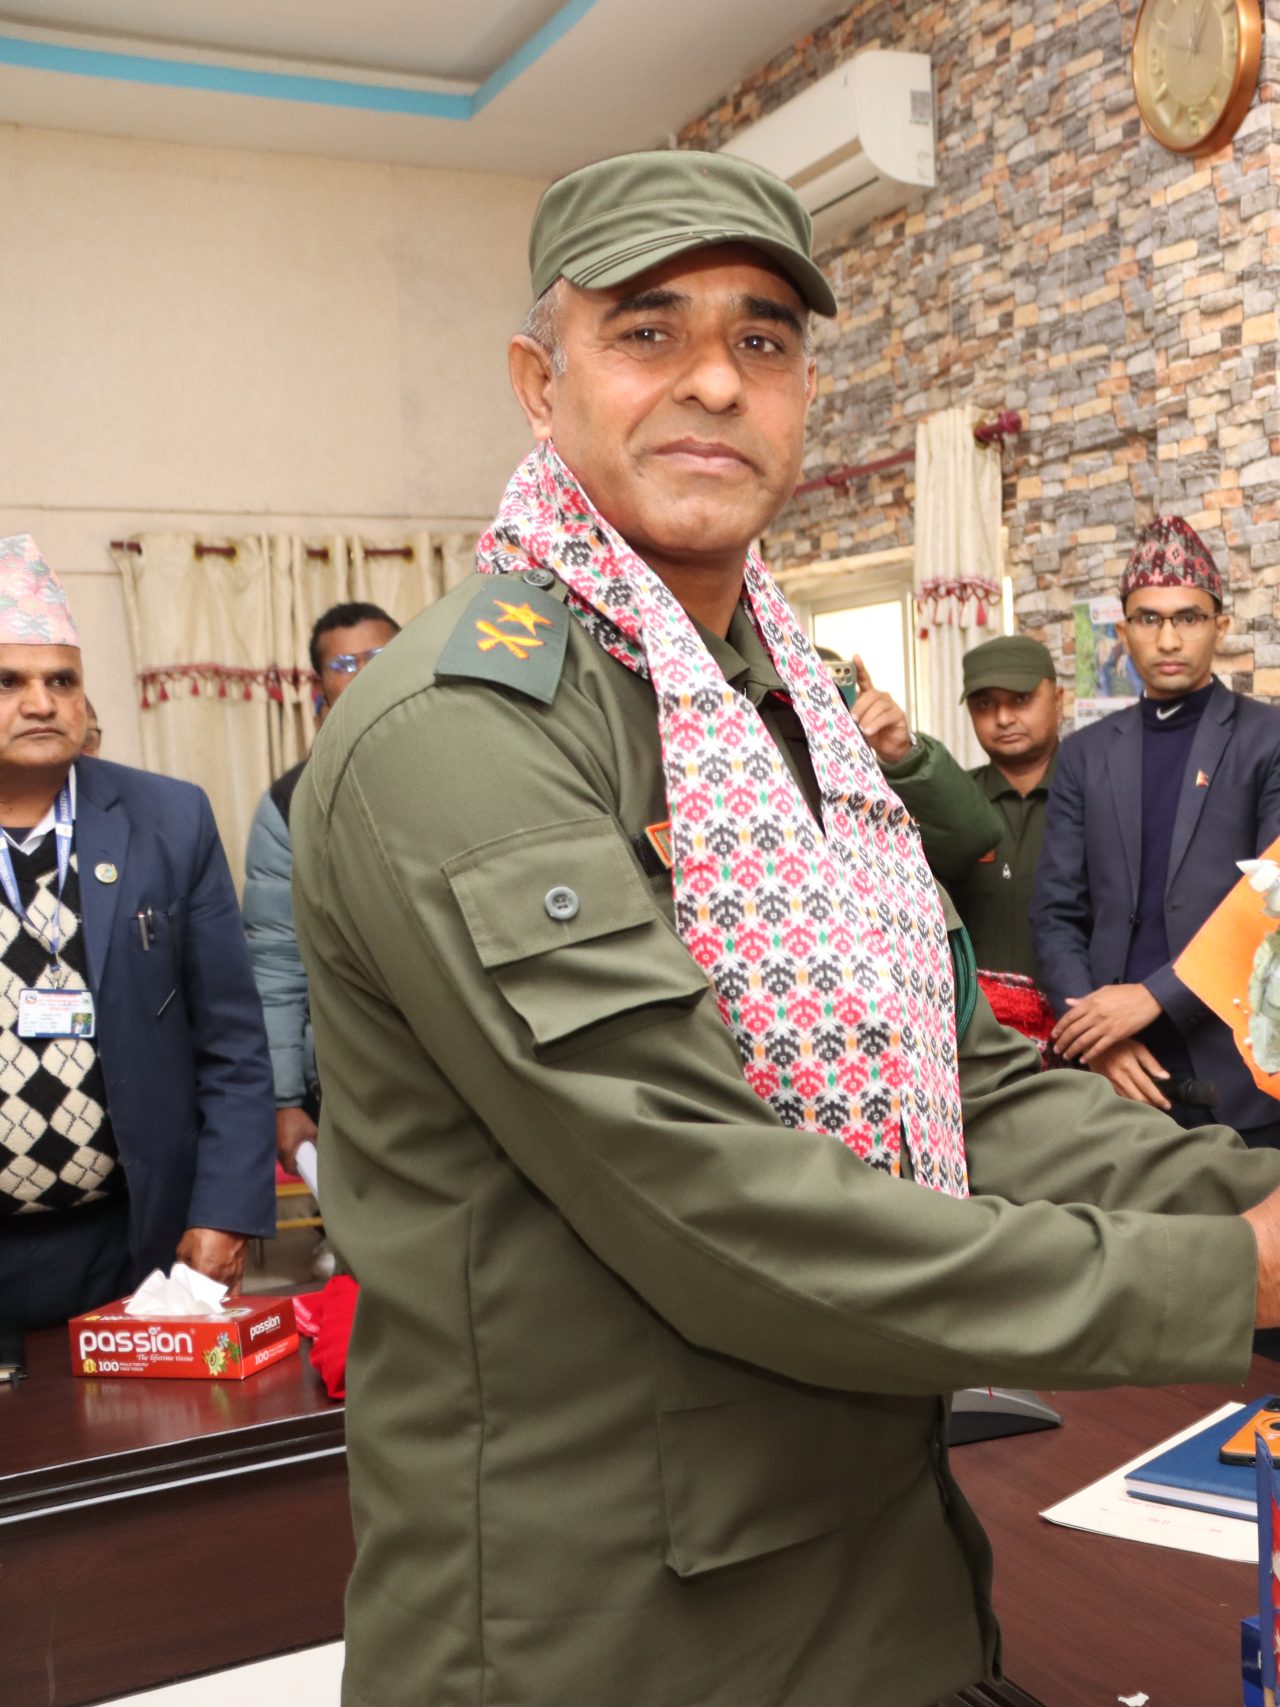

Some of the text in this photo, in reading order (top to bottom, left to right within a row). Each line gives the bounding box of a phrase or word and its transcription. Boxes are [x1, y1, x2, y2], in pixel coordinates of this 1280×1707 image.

[249, 1316, 280, 1341] passion
[80, 1328, 193, 1360] passion
[99, 1361, 119, 1372] 100
[255, 1350, 269, 1365] 100
